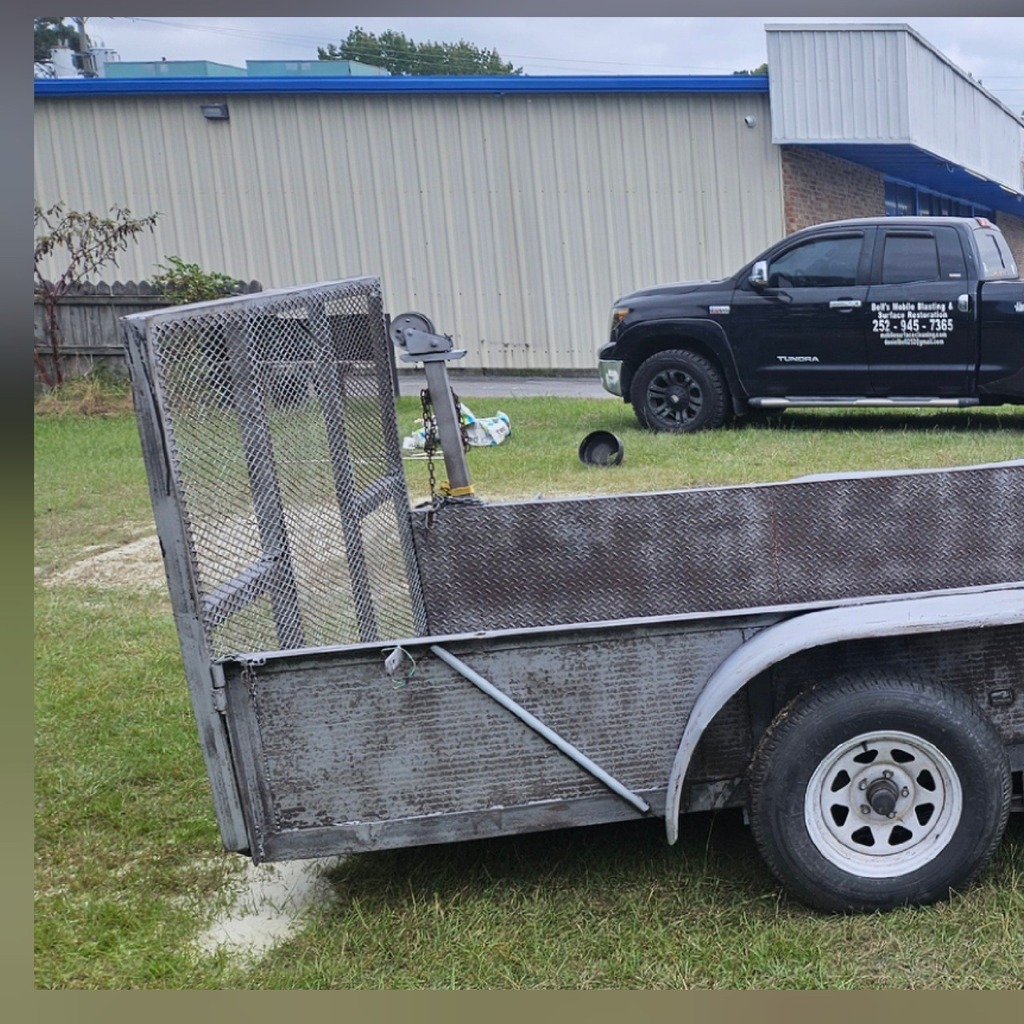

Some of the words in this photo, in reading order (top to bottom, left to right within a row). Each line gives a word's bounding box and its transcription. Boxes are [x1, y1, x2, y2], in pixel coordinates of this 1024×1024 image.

[871, 302, 890, 311] Bell's
[892, 302, 915, 311] Mobile
[917, 302, 946, 312] Blasting
[948, 302, 953, 310] &
[872, 319, 890, 332] 252
[900, 319, 920, 331] 945
[929, 319, 953, 331] 7365
